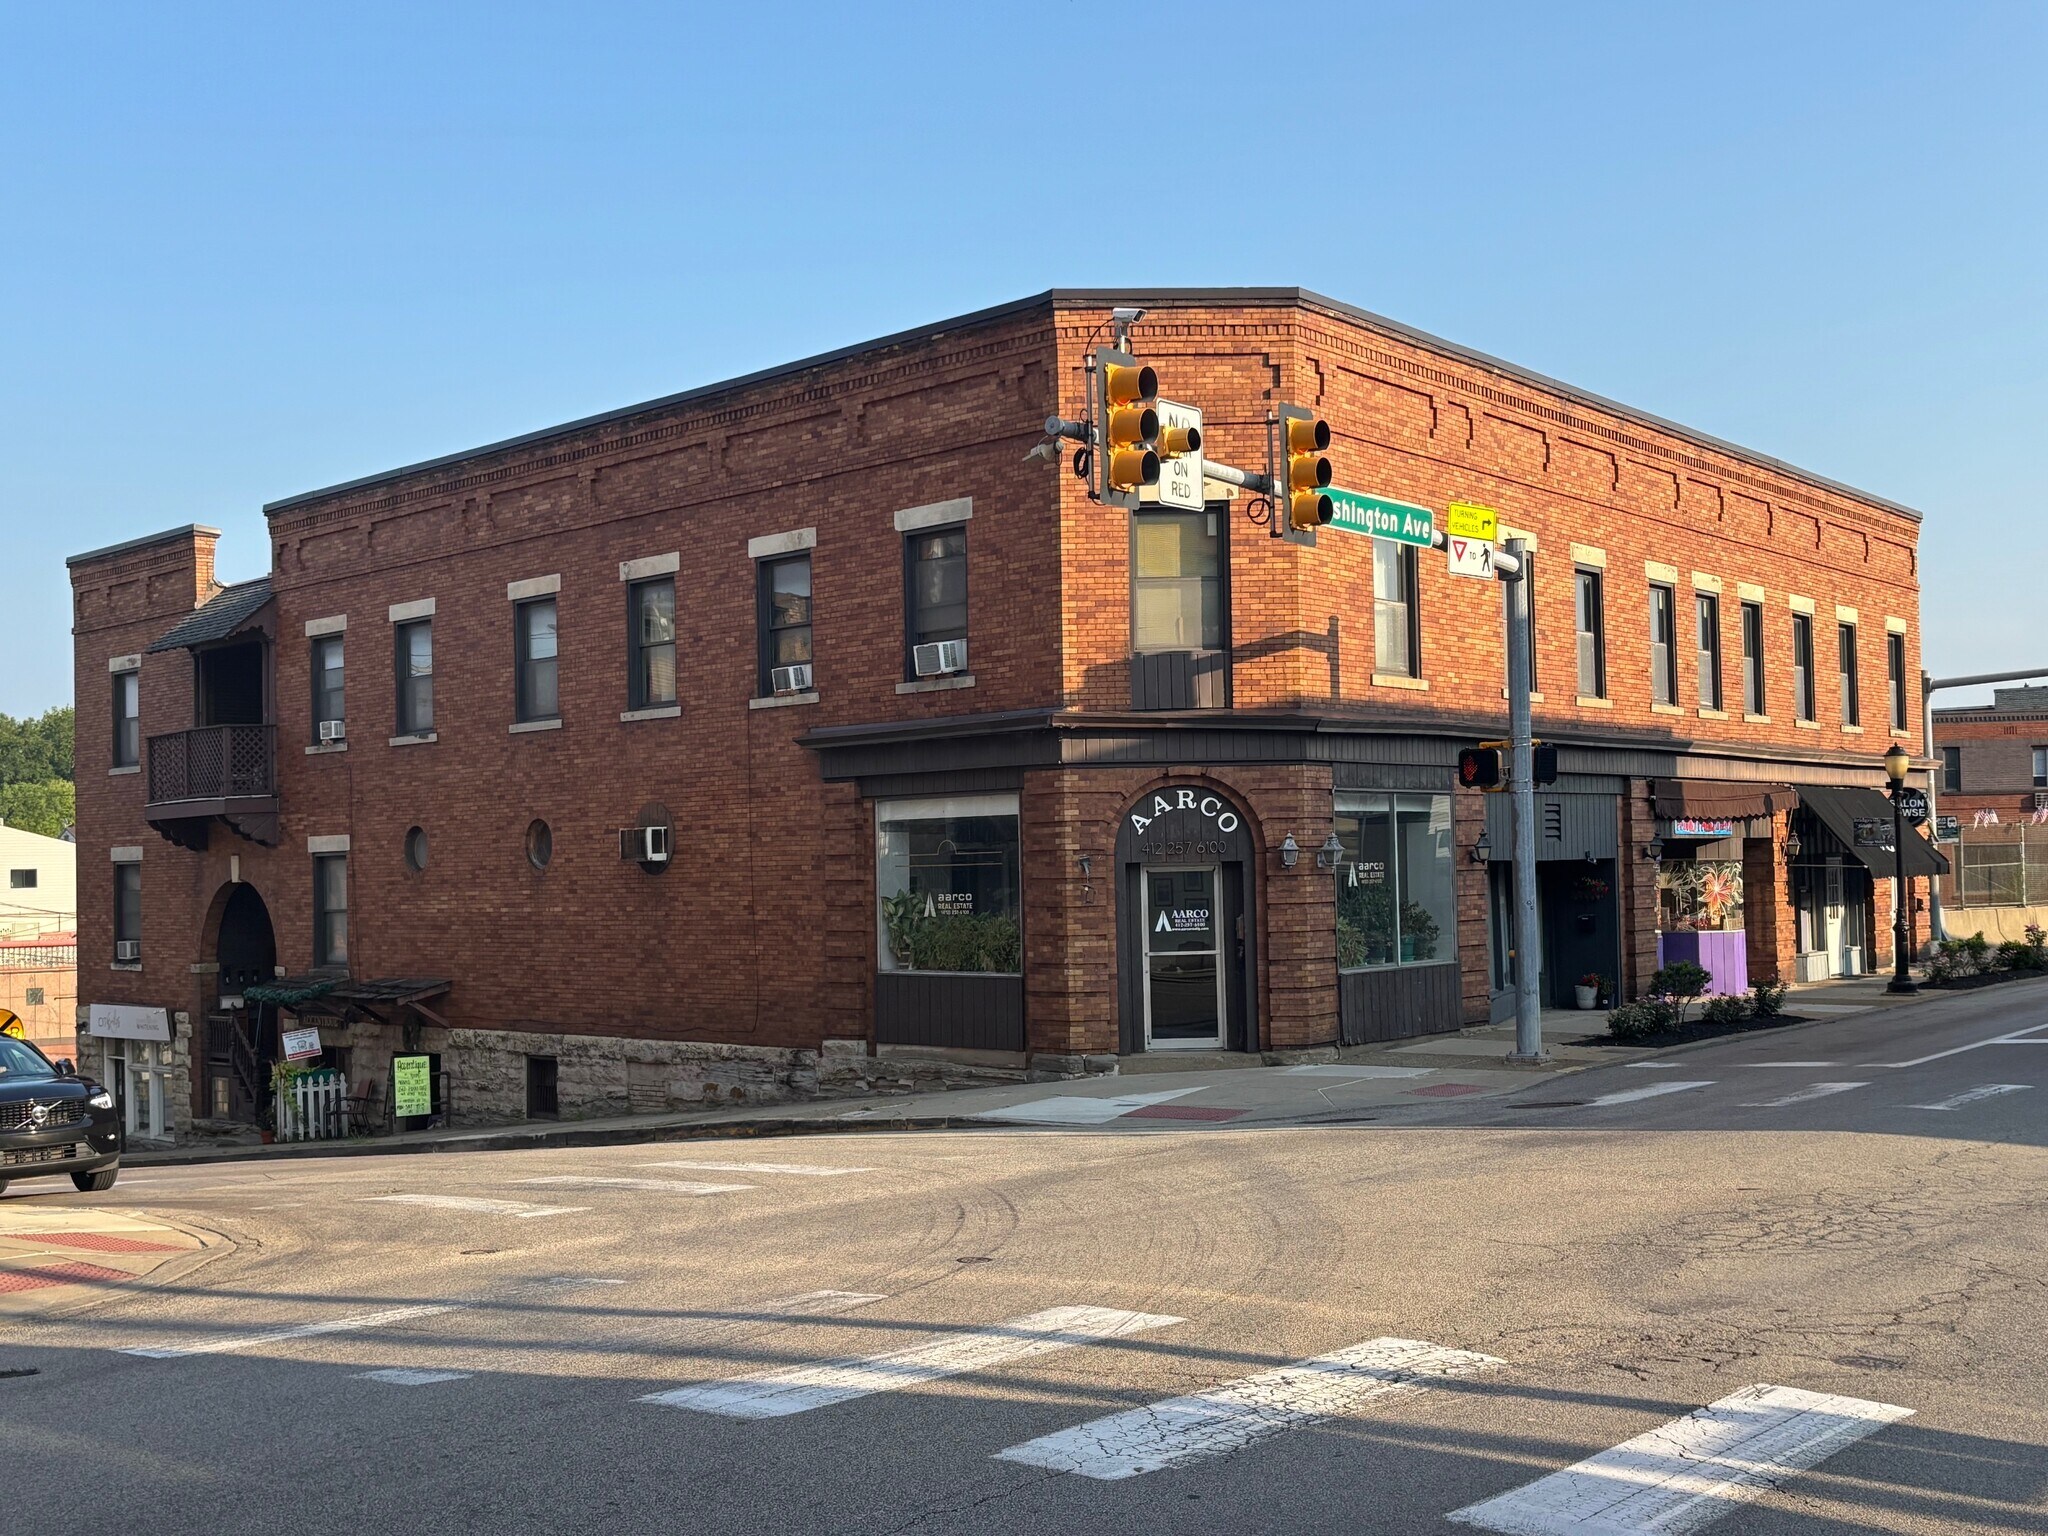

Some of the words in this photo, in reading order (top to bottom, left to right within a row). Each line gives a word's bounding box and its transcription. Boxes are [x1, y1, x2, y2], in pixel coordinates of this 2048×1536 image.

[1173, 460, 1188, 477] ON
[1171, 481, 1191, 498] RED
[1332, 498, 1398, 534] shington
[1402, 513, 1430, 538] Ave
[1454, 508, 1478, 521] TURNING
[1451, 522, 1479, 533] VEHICLES
[1469, 551, 1477, 560] TO
[1889, 799, 1925, 808] SLON
[1130, 790, 1238, 835] AARCO
[1142, 842, 1163, 855] 412
[1167, 842, 1192, 855] 257
[1196, 840, 1227, 854] 6100
[1358, 862, 1385, 871] aarco
[937, 893, 973, 902] aarco
[1171, 909, 1209, 919] AARCO
